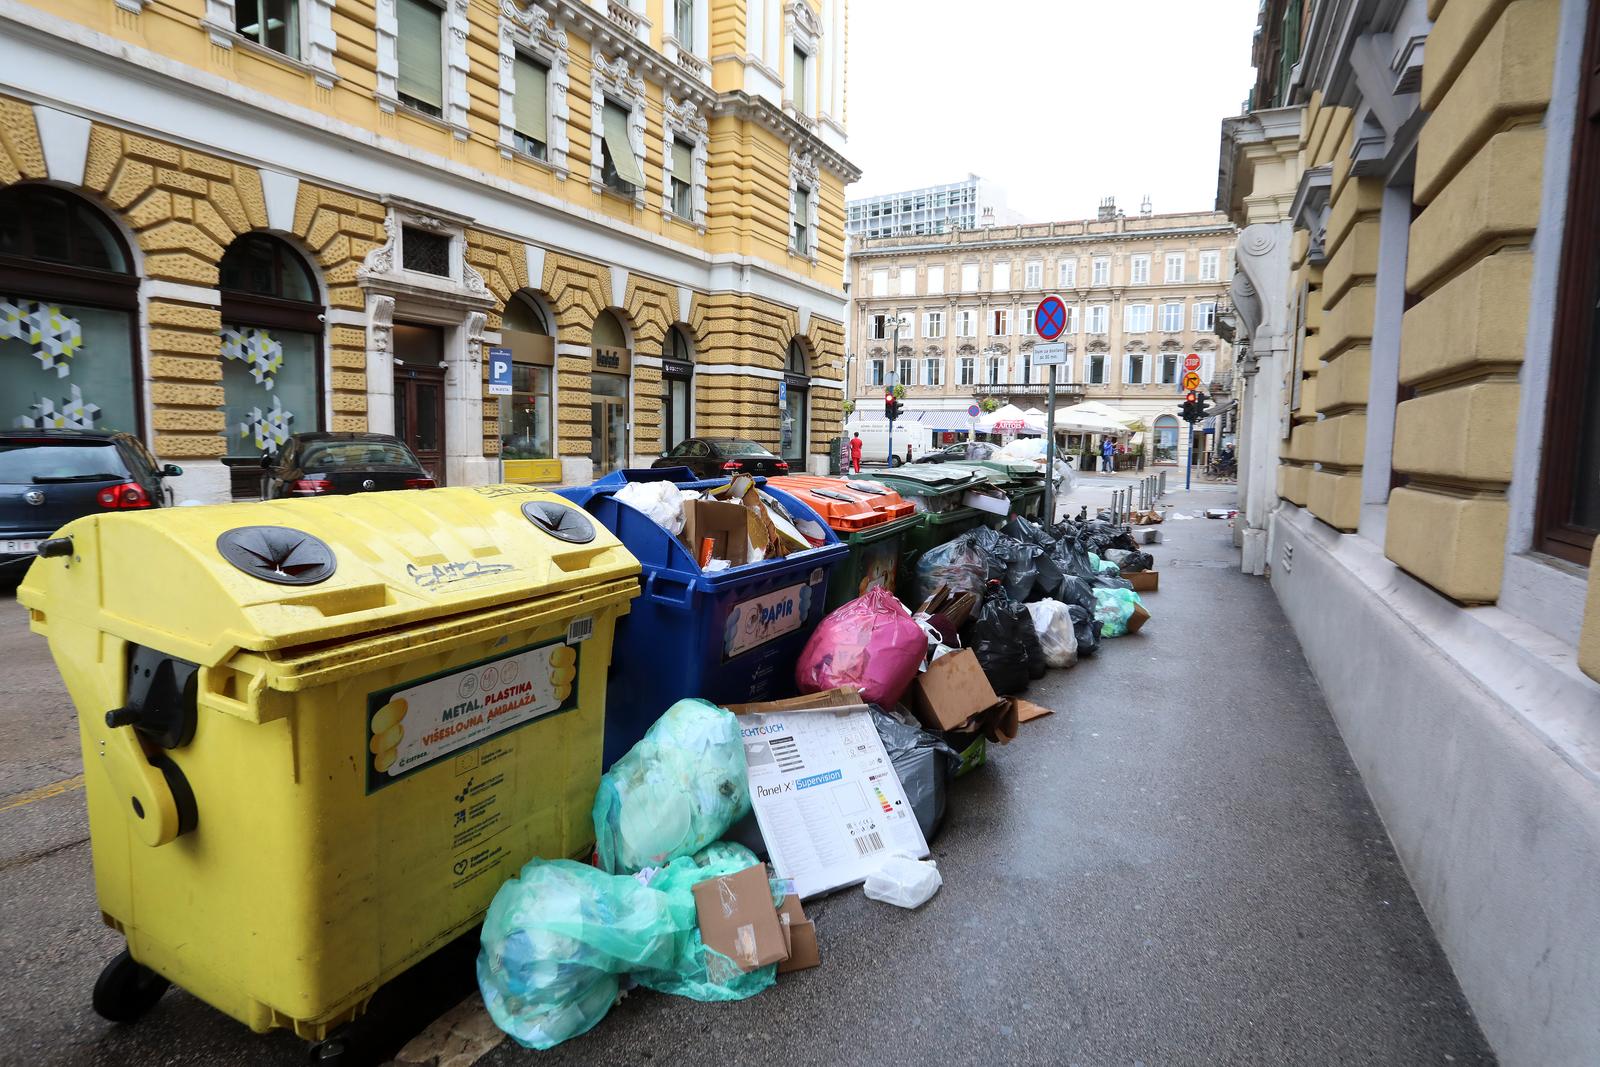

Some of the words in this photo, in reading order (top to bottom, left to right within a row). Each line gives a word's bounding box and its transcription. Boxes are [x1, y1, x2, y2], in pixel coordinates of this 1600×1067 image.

[494, 361, 508, 379] P
[1185, 358, 1199, 367] STOP
[760, 598, 793, 625] PAPIR
[484, 680, 532, 707] PLASTIKA
[422, 716, 484, 747] VIŠESLOJNA
[488, 693, 536, 719] AMBALAŽA
[757, 783, 782, 798] Panel
[796, 770, 842, 790] Supervision
